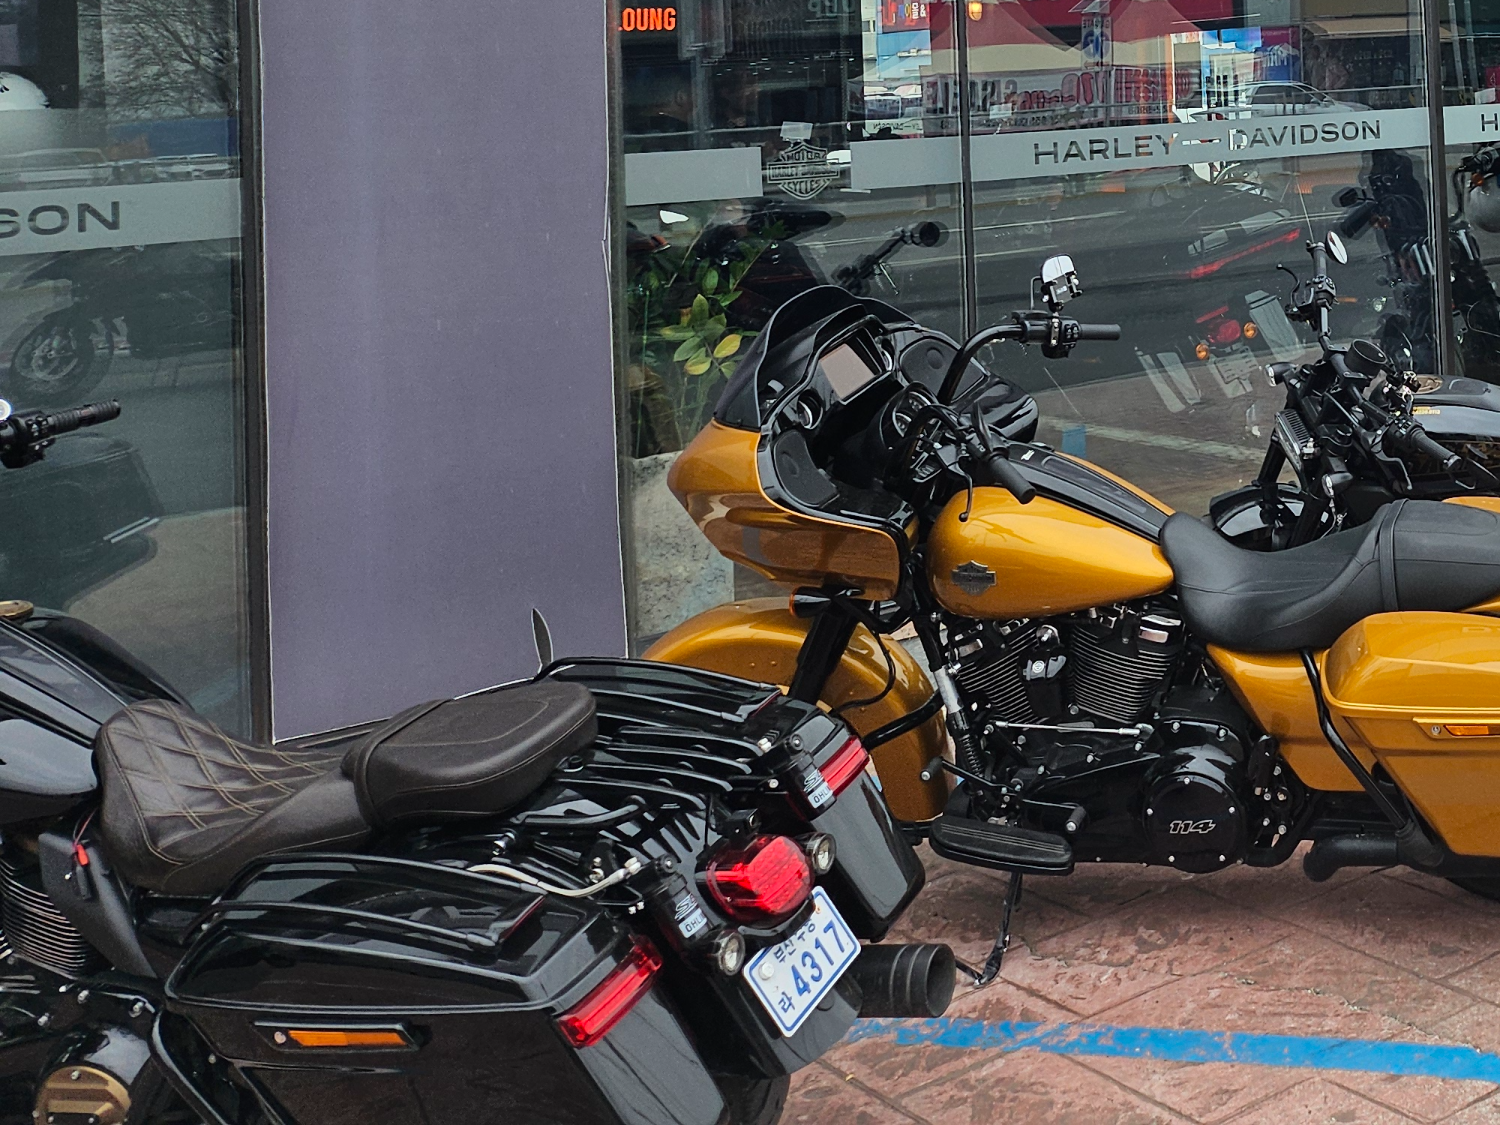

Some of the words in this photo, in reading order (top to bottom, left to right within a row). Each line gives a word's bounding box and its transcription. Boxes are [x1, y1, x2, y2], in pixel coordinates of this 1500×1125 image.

[618, 7, 677, 31] OUNG
[1033, 133, 1178, 165] HARLEY
[1228, 120, 1382, 152] DAVIDSON
[1169, 819, 1217, 835] 114
[790, 919, 846, 997] 4317
